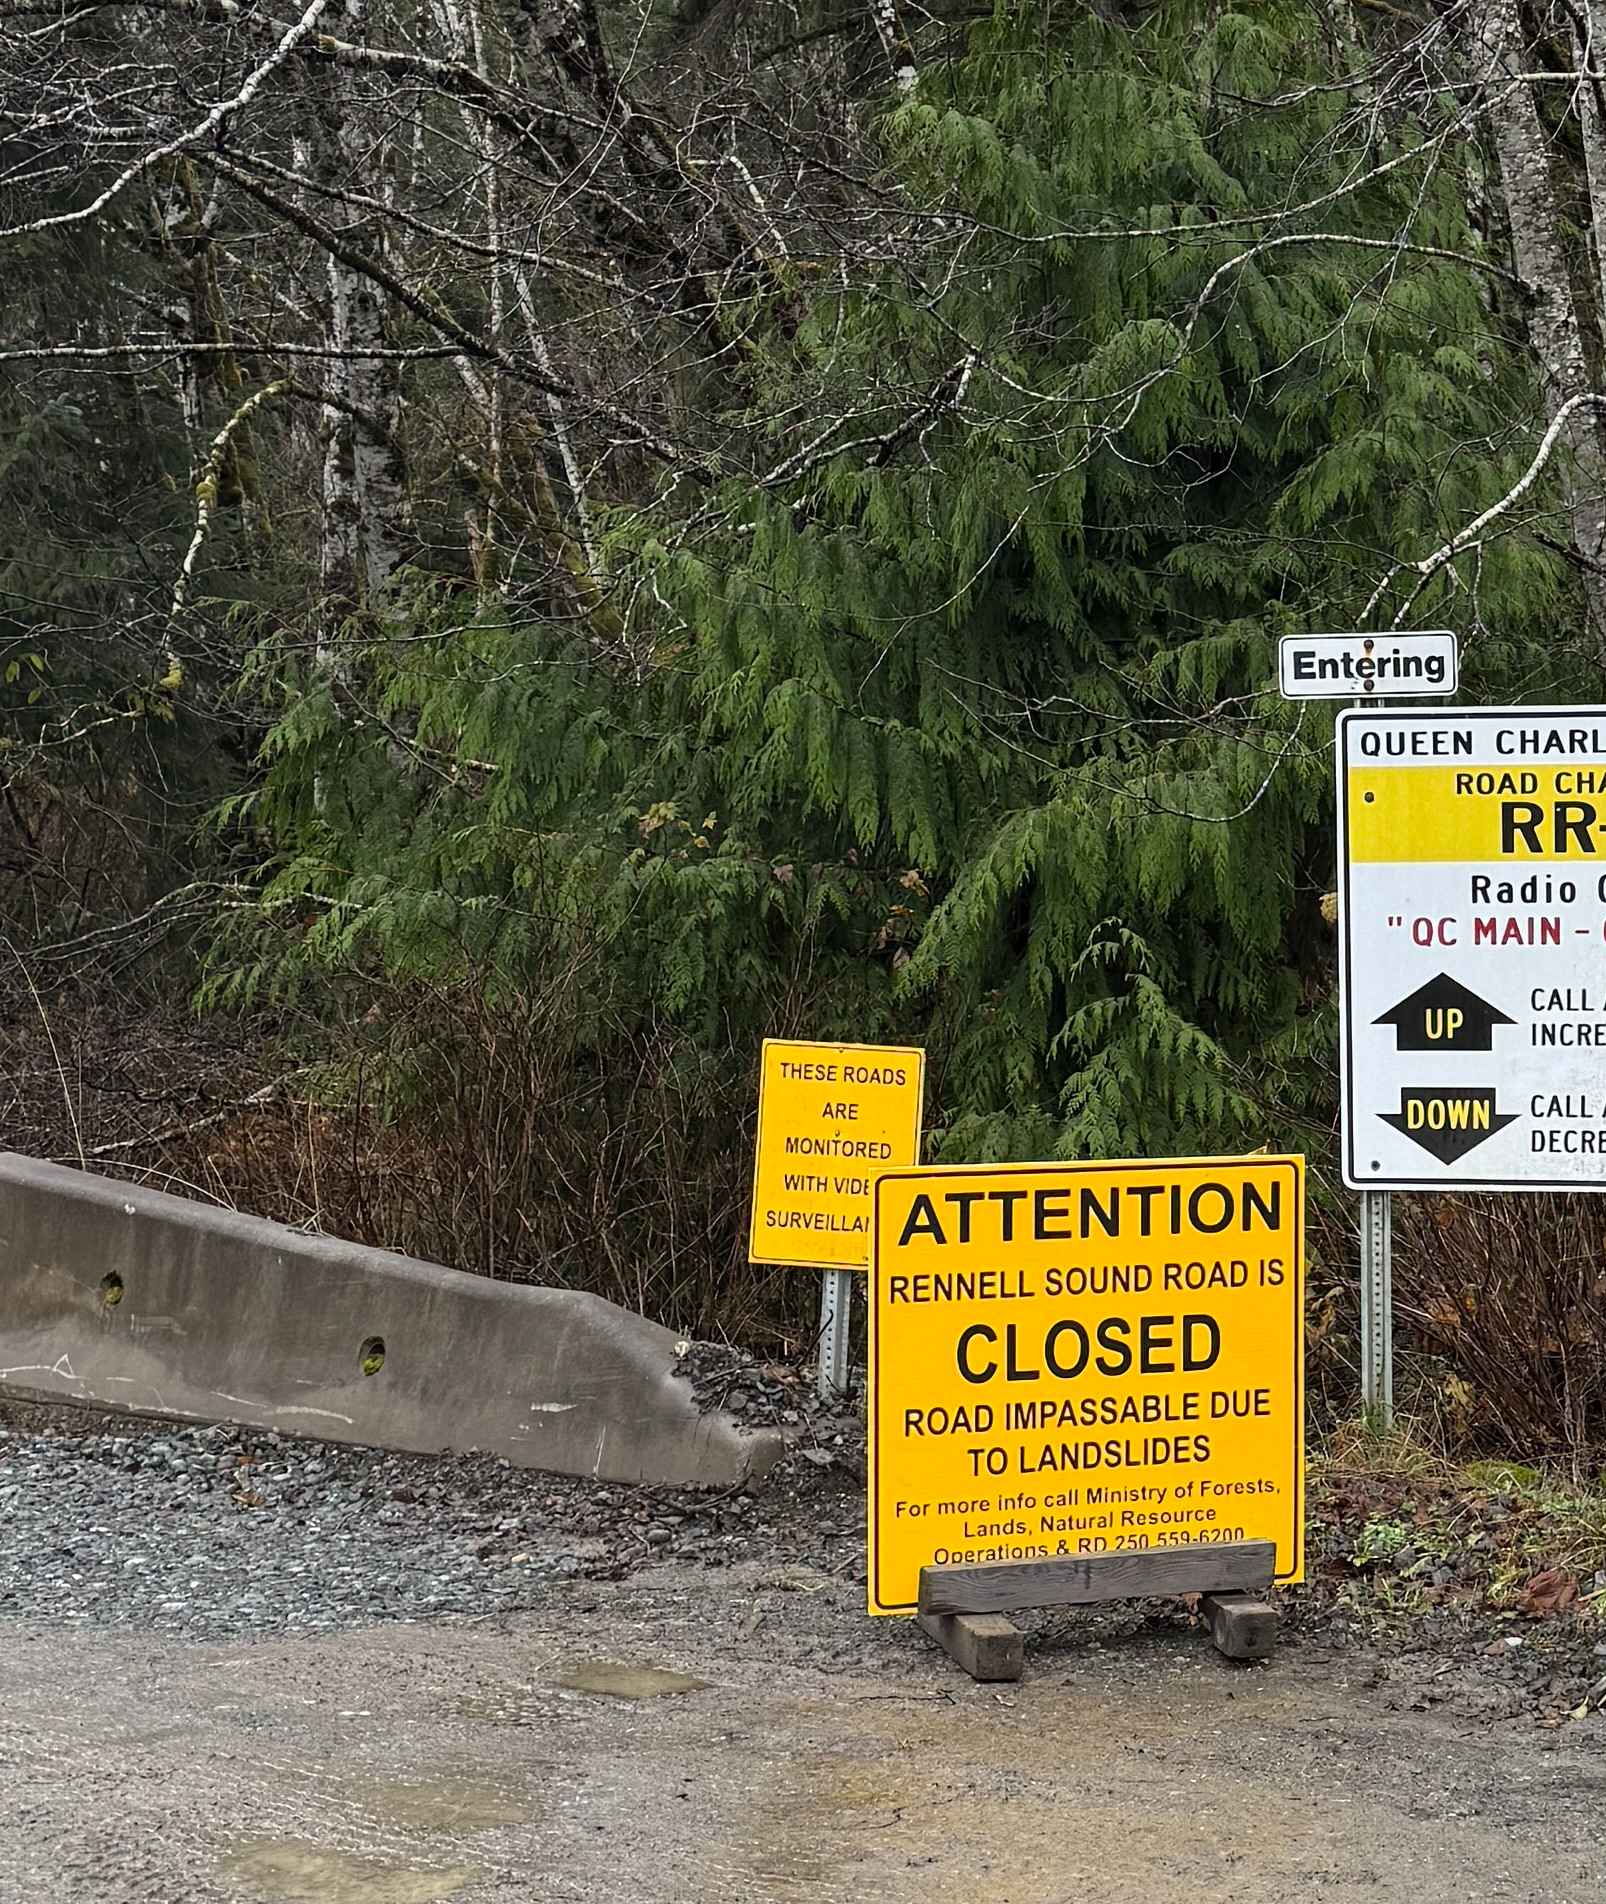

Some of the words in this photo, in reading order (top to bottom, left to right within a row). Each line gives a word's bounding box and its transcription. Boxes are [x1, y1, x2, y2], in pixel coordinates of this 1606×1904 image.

[1292, 650, 1446, 684] Entering
[1360, 731, 1473, 757] QUEEN
[1456, 772, 1537, 795] ROAD
[1471, 875, 1576, 904] Radio
[1474, 917, 1561, 945] MAIN
[1531, 988, 1594, 1011] CALL
[1425, 1008, 1464, 1040] UP
[780, 1063, 838, 1081] THESE
[843, 1066, 906, 1085] ROADS
[822, 1103, 859, 1119] ARE
[1407, 1099, 1491, 1131] DOWN
[1531, 1095, 1593, 1118] CALL
[785, 1137, 891, 1160] MONITORED
[785, 1174, 828, 1192] WITH
[766, 1211, 869, 1232] SURVEILLA
[897, 1181, 1281, 1247] ATTENTION
[889, 1269, 1035, 1304] RENNELL
[1045, 1265, 1152, 1297] SOUND
[1164, 1261, 1248, 1292] ROAD
[1258, 1259, 1284, 1287] IS
[956, 1313, 1222, 1385] CLOSED
[904, 1404, 993, 1438] ROAD
[1005, 1392, 1200, 1430] IMPASSABLE
[1209, 1389, 1272, 1419] DUE
[968, 1447, 1008, 1477] TO
[1019, 1434, 1211, 1475] LANDSLIDES
[896, 1501, 930, 1518] For
[938, 1498, 990, 1514] more
[998, 1492, 1037, 1511] info
[1044, 1488, 1079, 1508] call
[1087, 1484, 1165, 1506] Ministry
[1174, 1482, 1194, 1498] of
[1200, 1478, 1280, 1497] Forests,
[964, 1519, 1033, 1538] Lands,
[1040, 1511, 1114, 1534] Natural
[1121, 1507, 1217, 1526] Resource
[934, 1542, 1048, 1565] Operations
[1057, 1540, 1070, 1554] &
[1078, 1537, 1107, 1553] RD
[1116, 1534, 1149, 1549] 250
